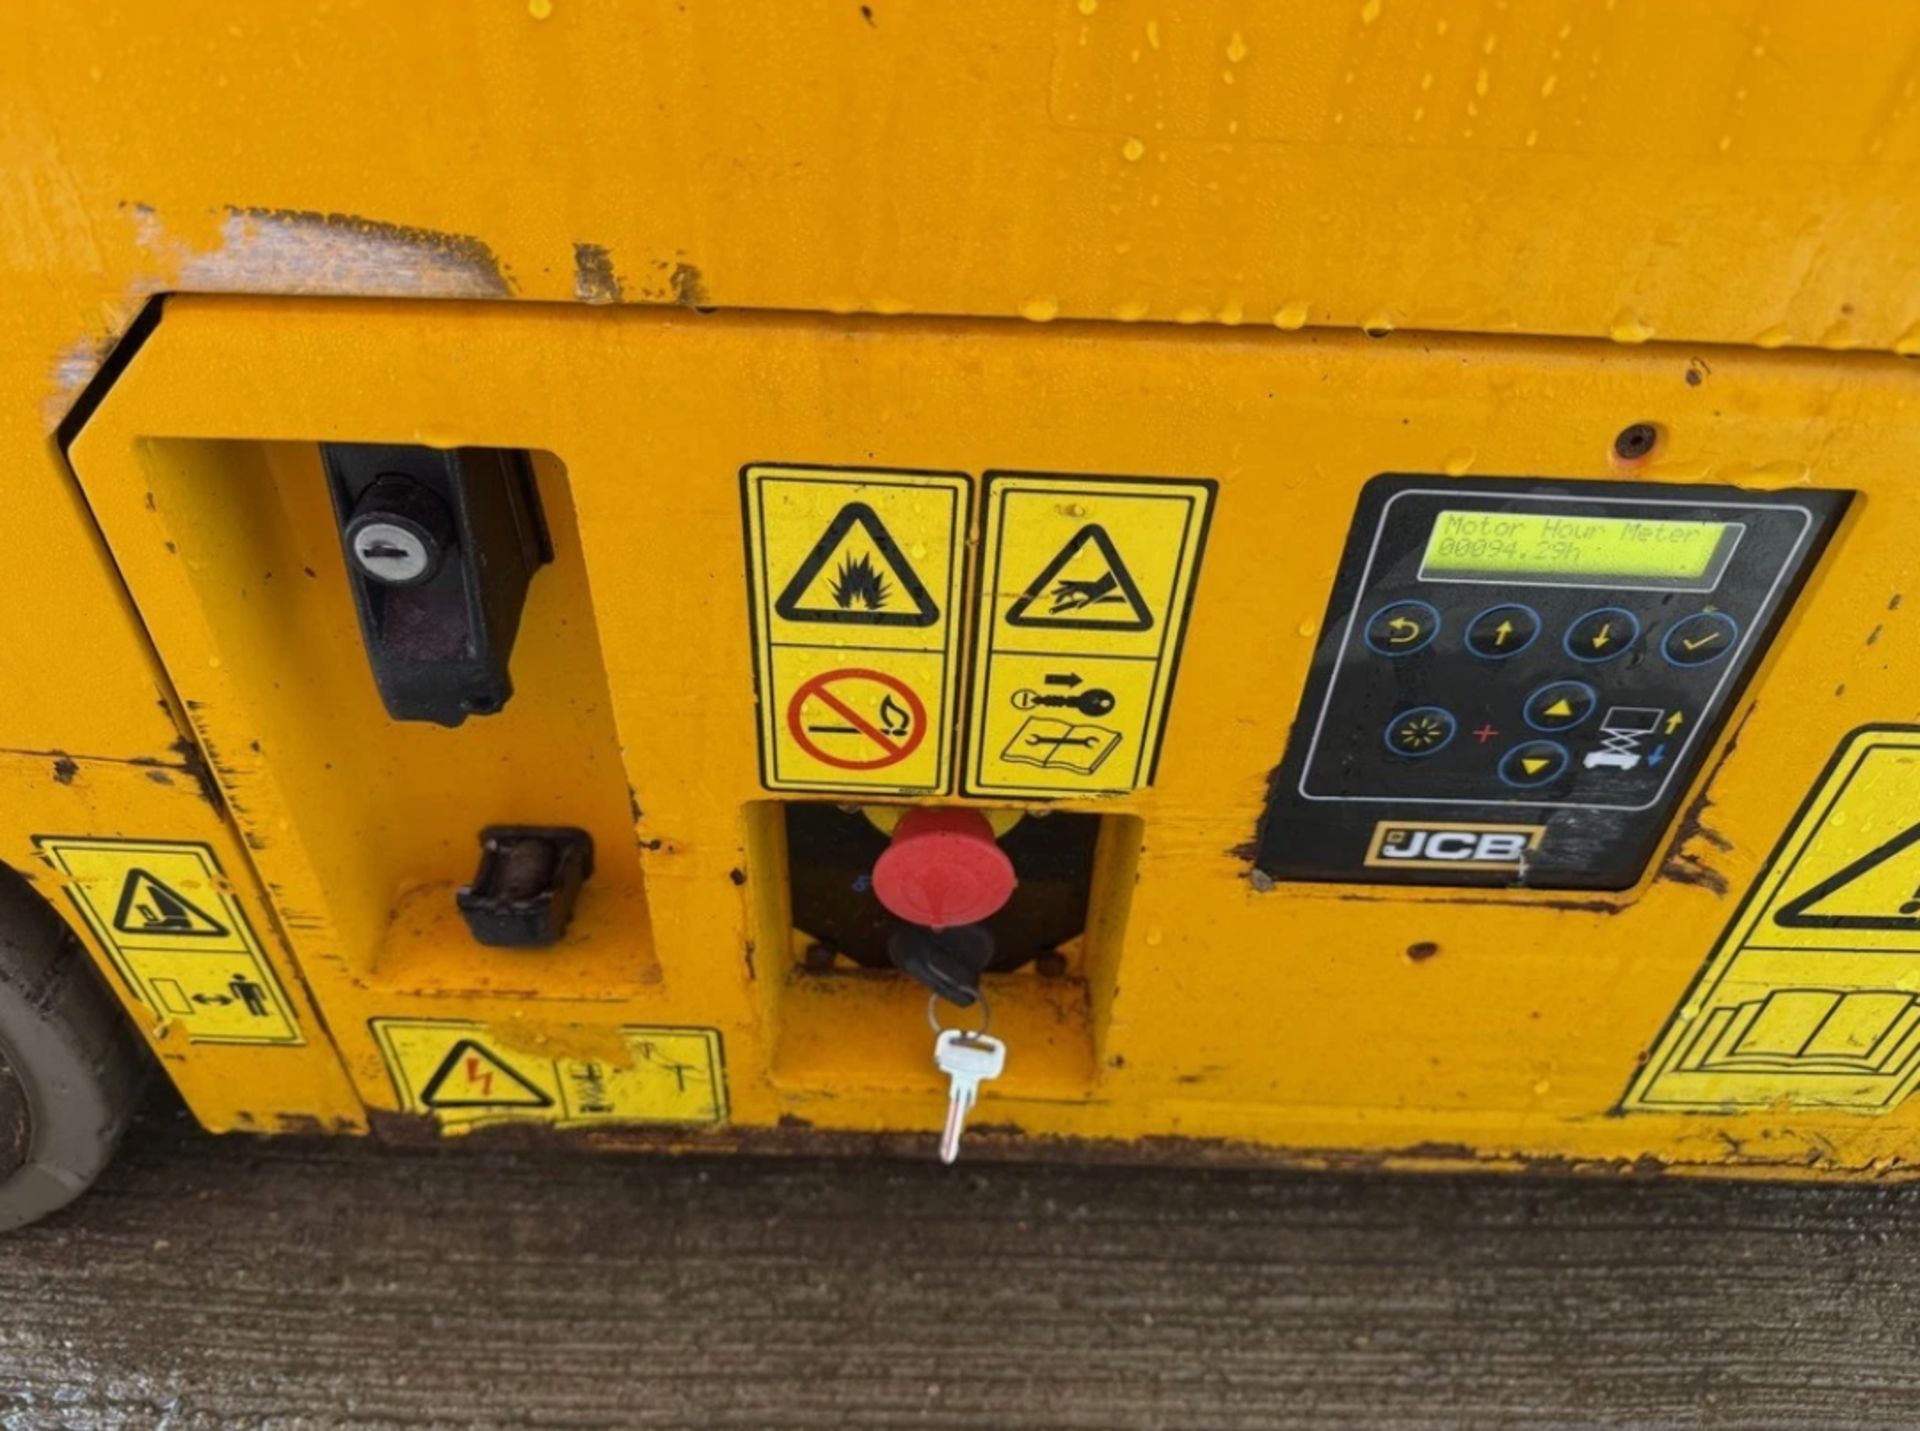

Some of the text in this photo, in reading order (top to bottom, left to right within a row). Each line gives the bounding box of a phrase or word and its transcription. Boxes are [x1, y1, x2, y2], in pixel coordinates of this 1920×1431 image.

[1443, 514, 1700, 543] Motor Hour Meter
[1438, 537, 1581, 561] 00094.29h
[1382, 831, 1527, 861] JCB
